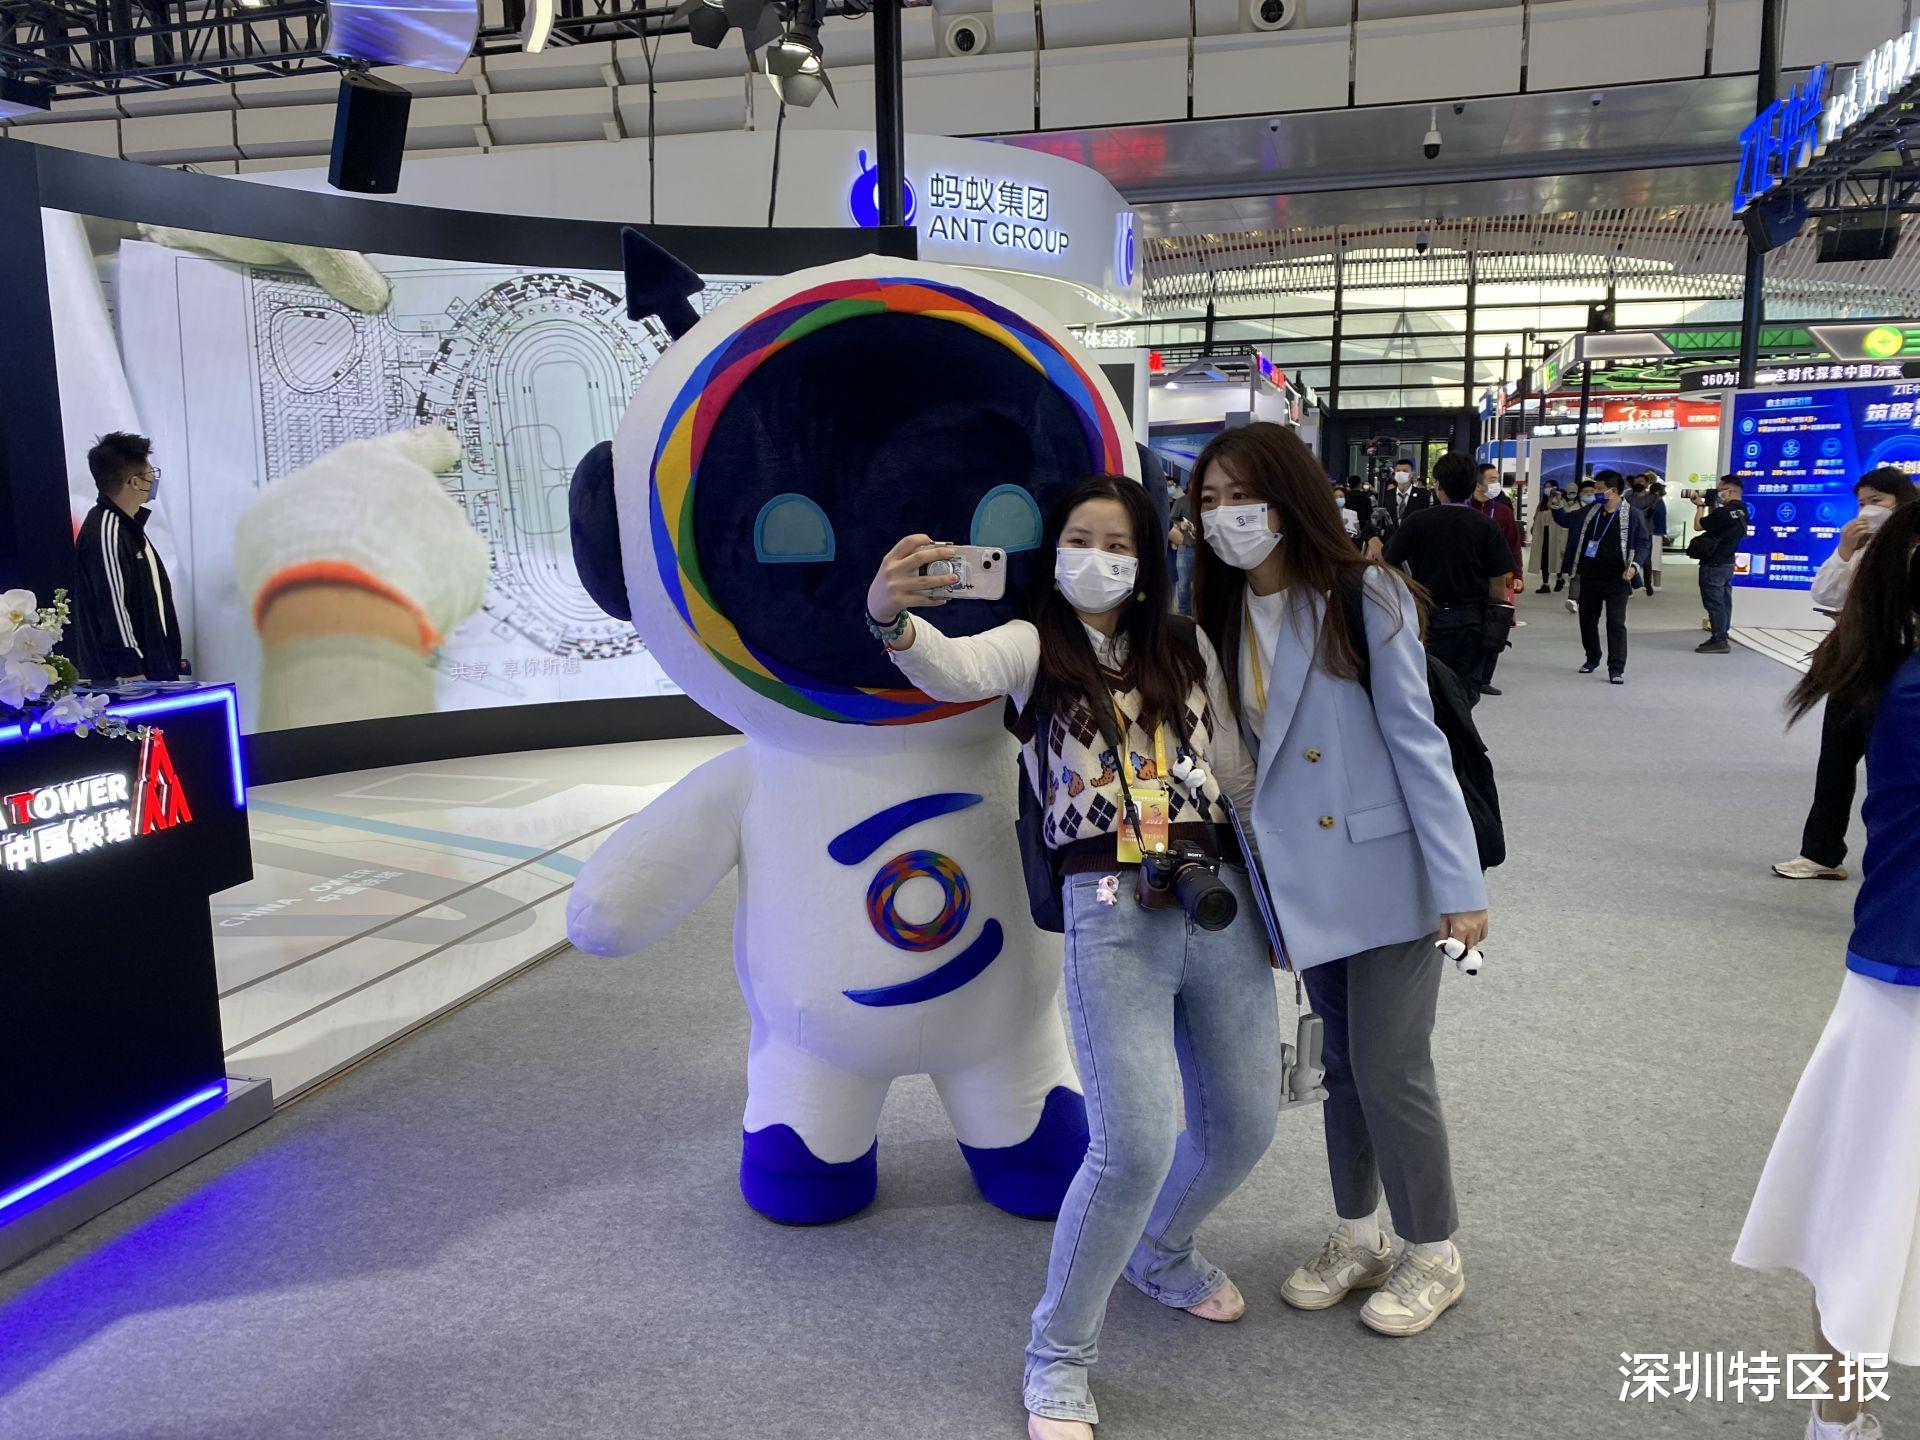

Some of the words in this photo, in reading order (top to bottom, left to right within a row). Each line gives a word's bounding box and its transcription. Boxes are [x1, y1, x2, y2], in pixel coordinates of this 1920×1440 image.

[929, 173, 1049, 222] 蚂蚁集团
[929, 215, 987, 243] ANT
[991, 222, 1069, 255] GROUP
[449, 663, 489, 682] 共享
[502, 656, 581, 679] 享你所想
[4, 772, 129, 824] TOWER
[1, 808, 132, 871] 中国铁塔
[218, 898, 303, 927] CHINA
